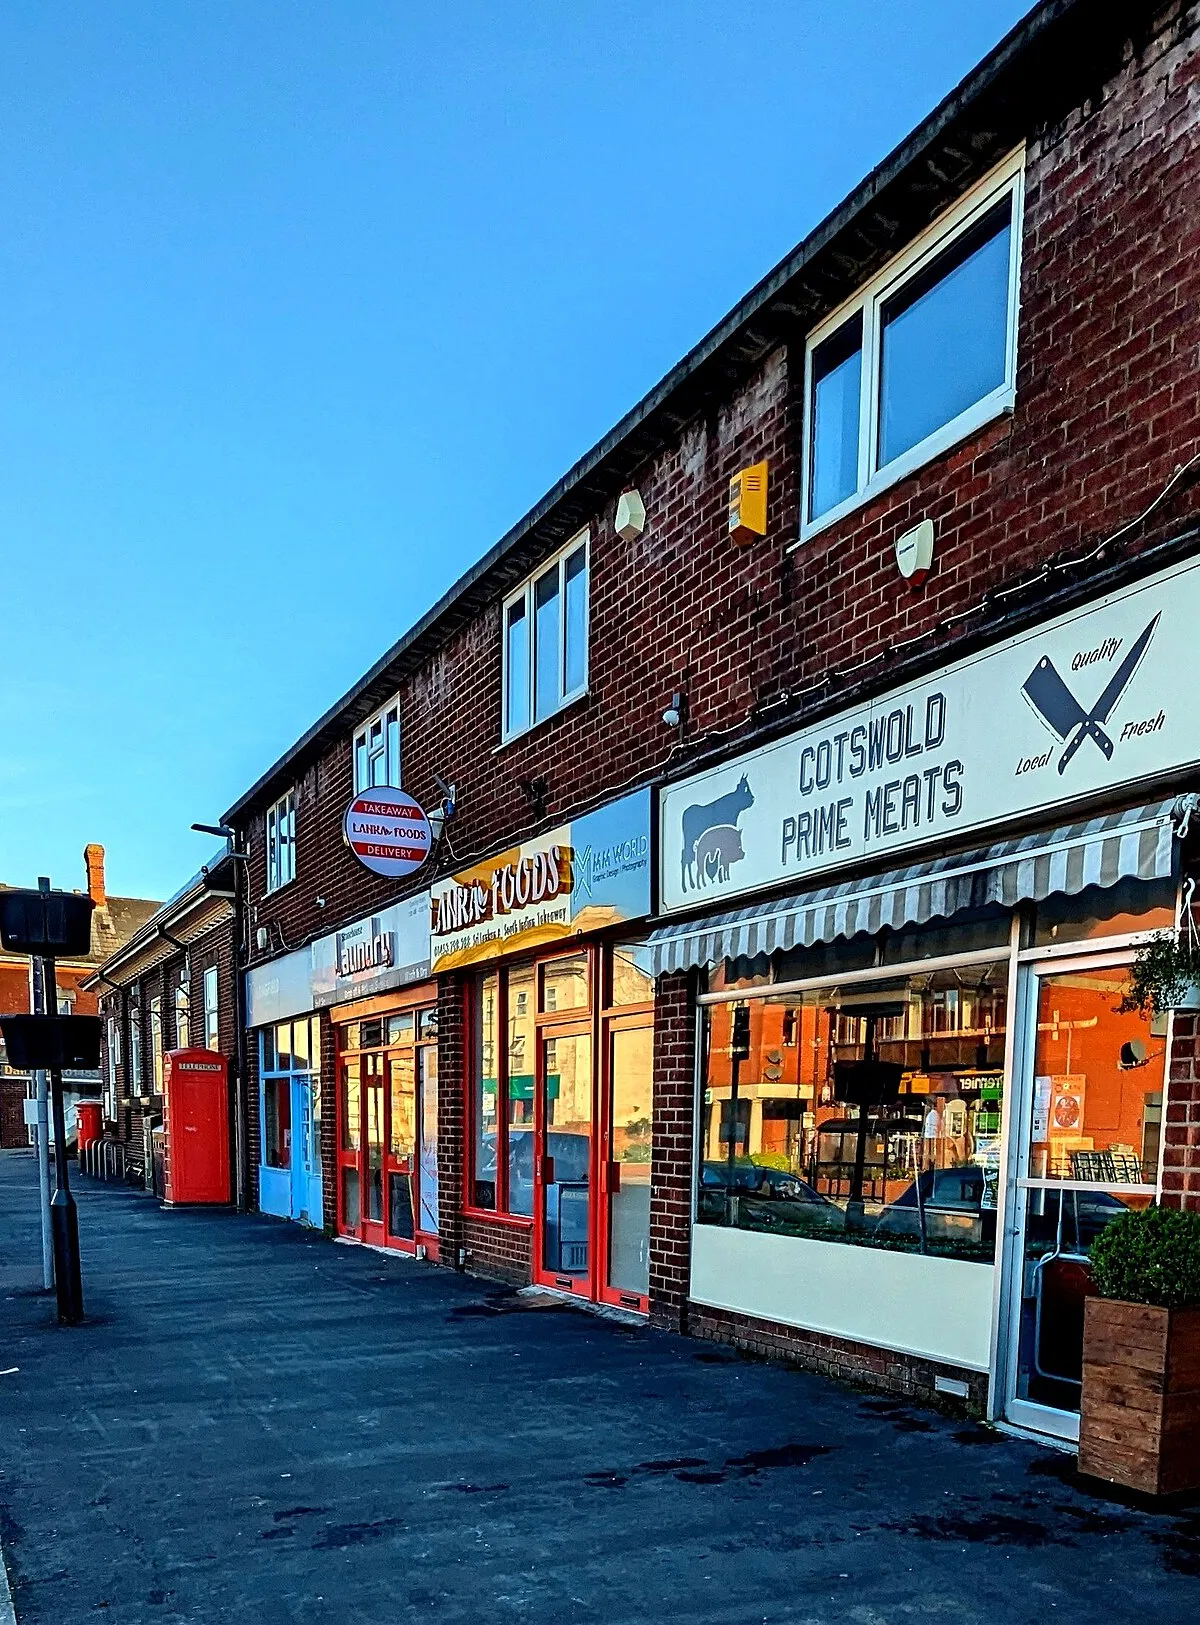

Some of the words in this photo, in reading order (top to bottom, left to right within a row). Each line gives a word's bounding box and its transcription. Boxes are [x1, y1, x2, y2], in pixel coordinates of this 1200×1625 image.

[1071, 638, 1123, 671] Quality
[1120, 710, 1165, 742] Fresh
[800, 692, 946, 796] COTSWOLD
[1015, 746, 1054, 776] Local
[363, 803, 413, 817] TAKEAWAY
[782, 797, 853, 865] PRIME
[864, 760, 964, 841] MEATS
[352, 822, 390, 836] LANKA
[394, 827, 427, 840] FOODS
[367, 845, 412, 858] DELIVERY
[612, 835, 648, 864] WORLD
[491, 845, 561, 914] FOODS
